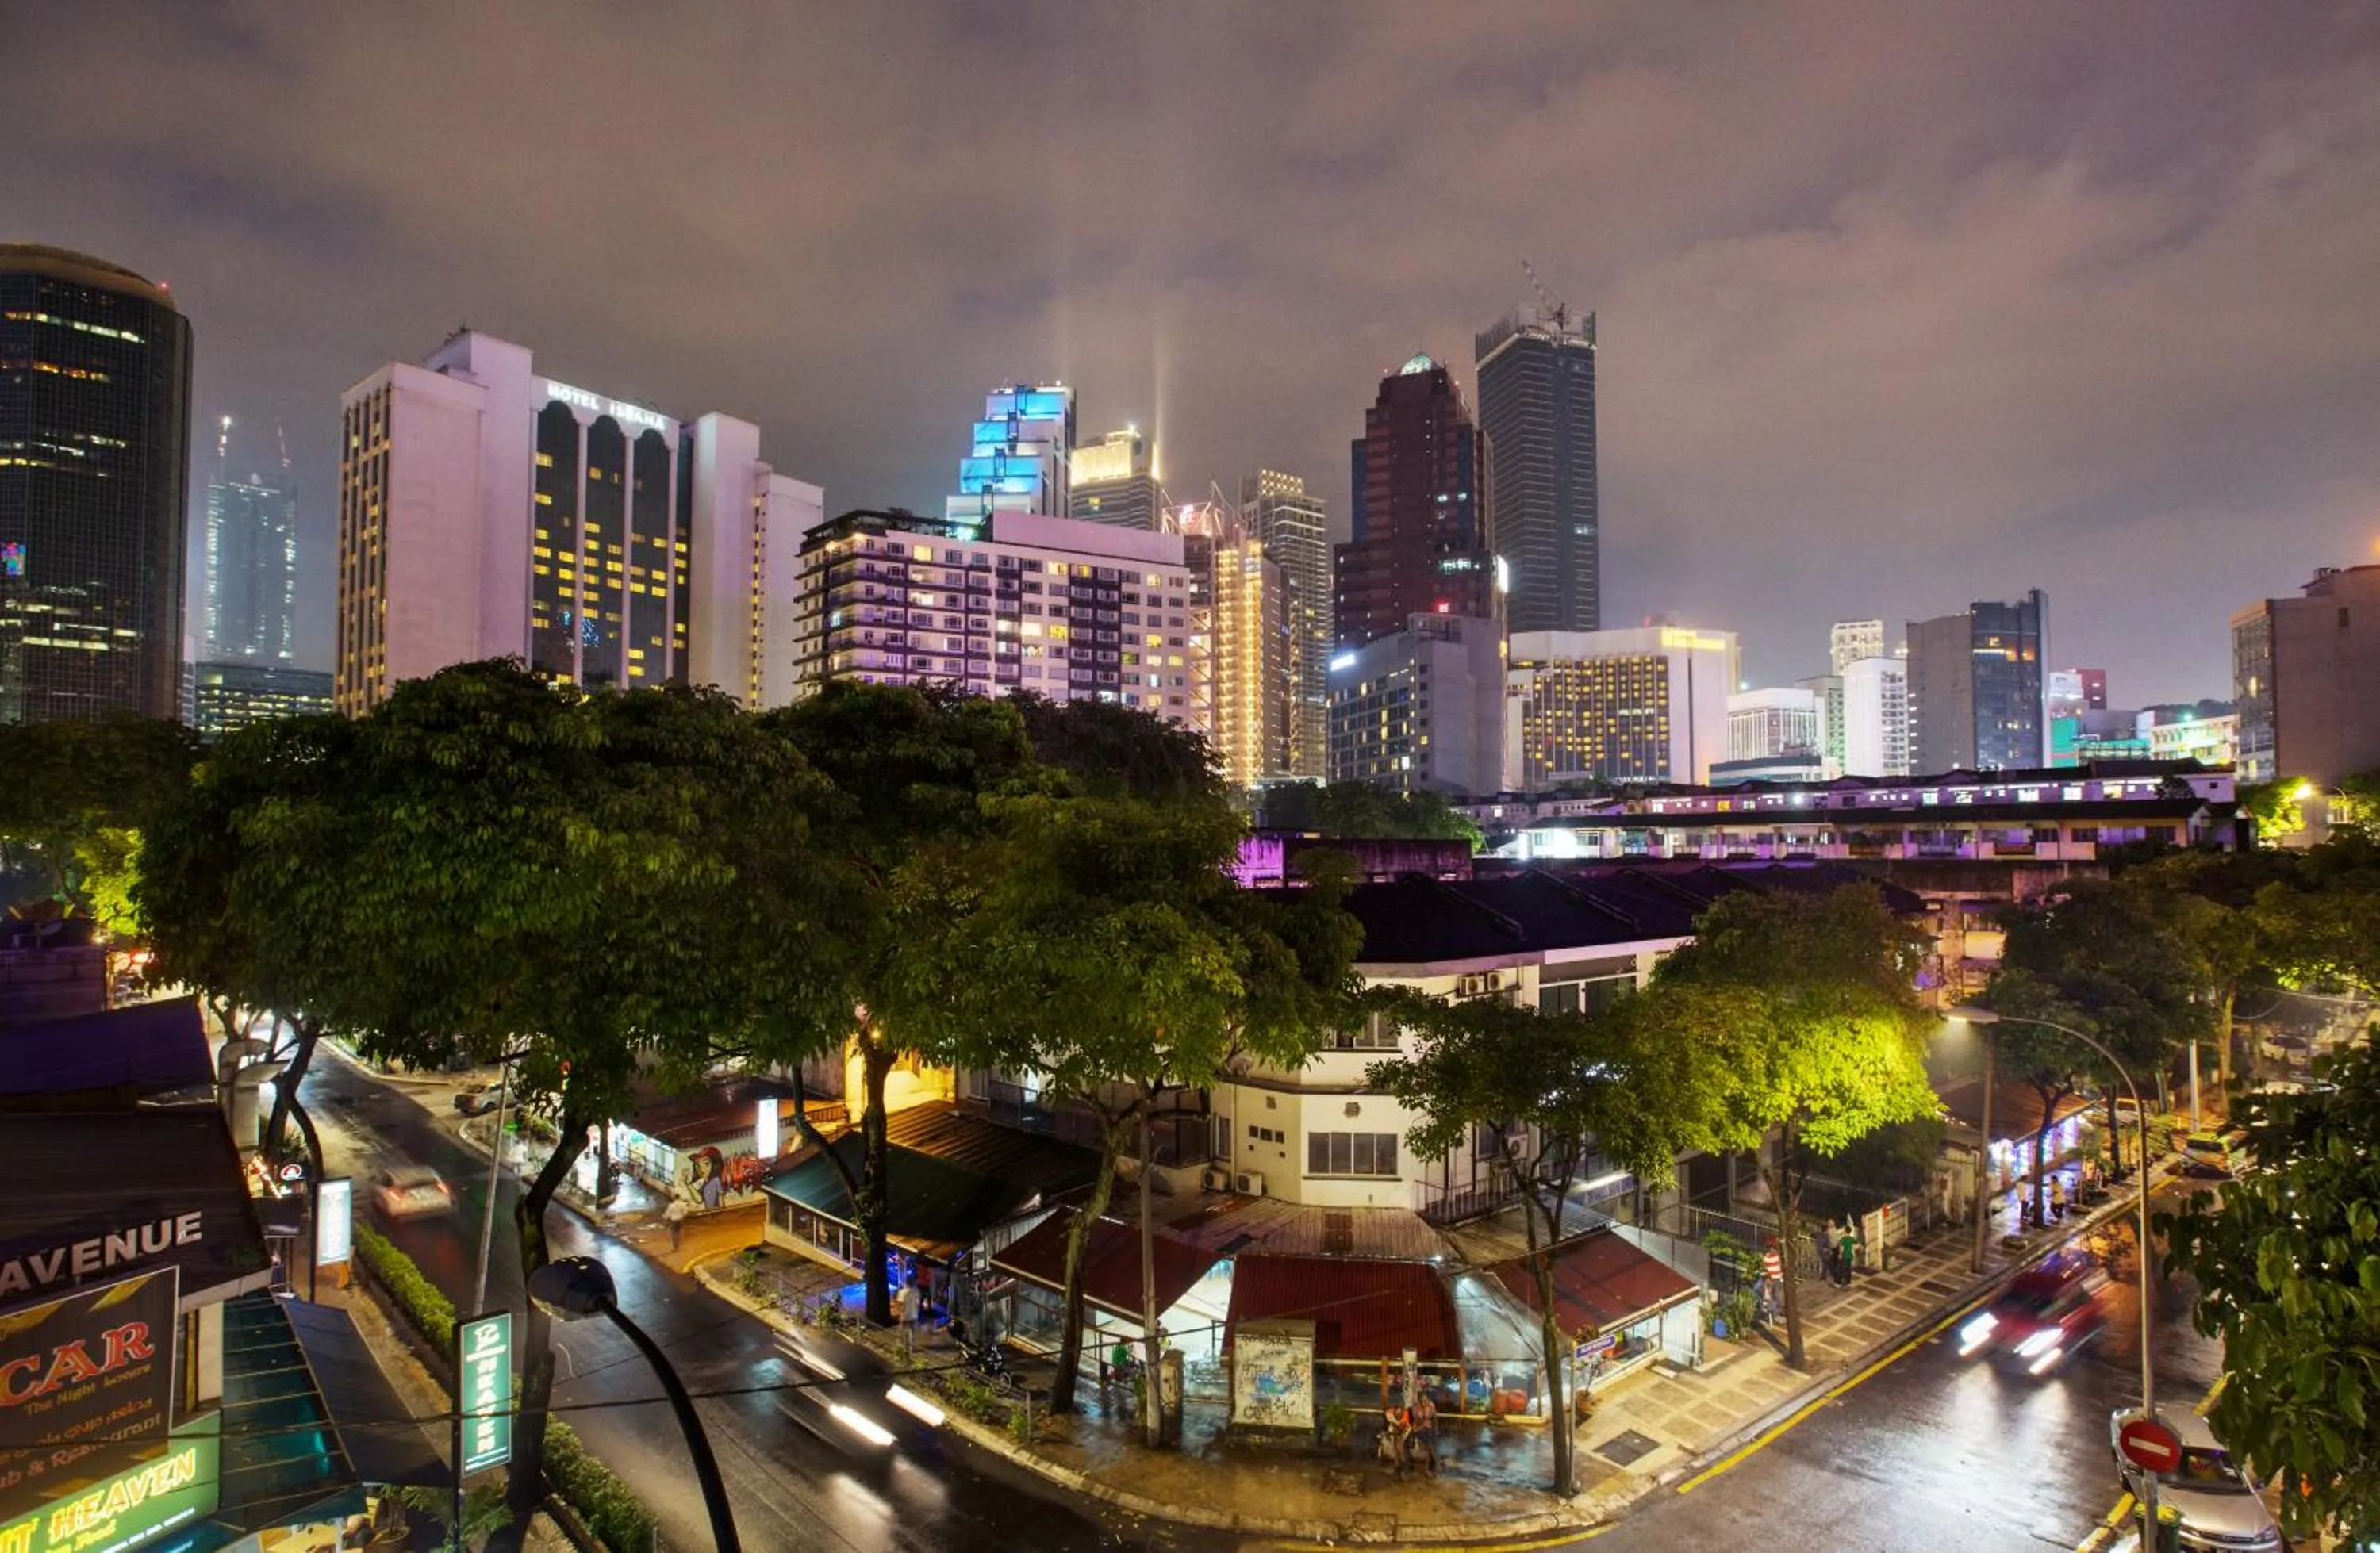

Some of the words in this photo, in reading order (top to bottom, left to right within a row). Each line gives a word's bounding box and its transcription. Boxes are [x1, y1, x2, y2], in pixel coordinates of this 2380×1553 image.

[548, 382, 600, 411] HOTEL
[0, 1211, 202, 1296] AVENUE
[48, 1447, 197, 1545] HEAVEN
